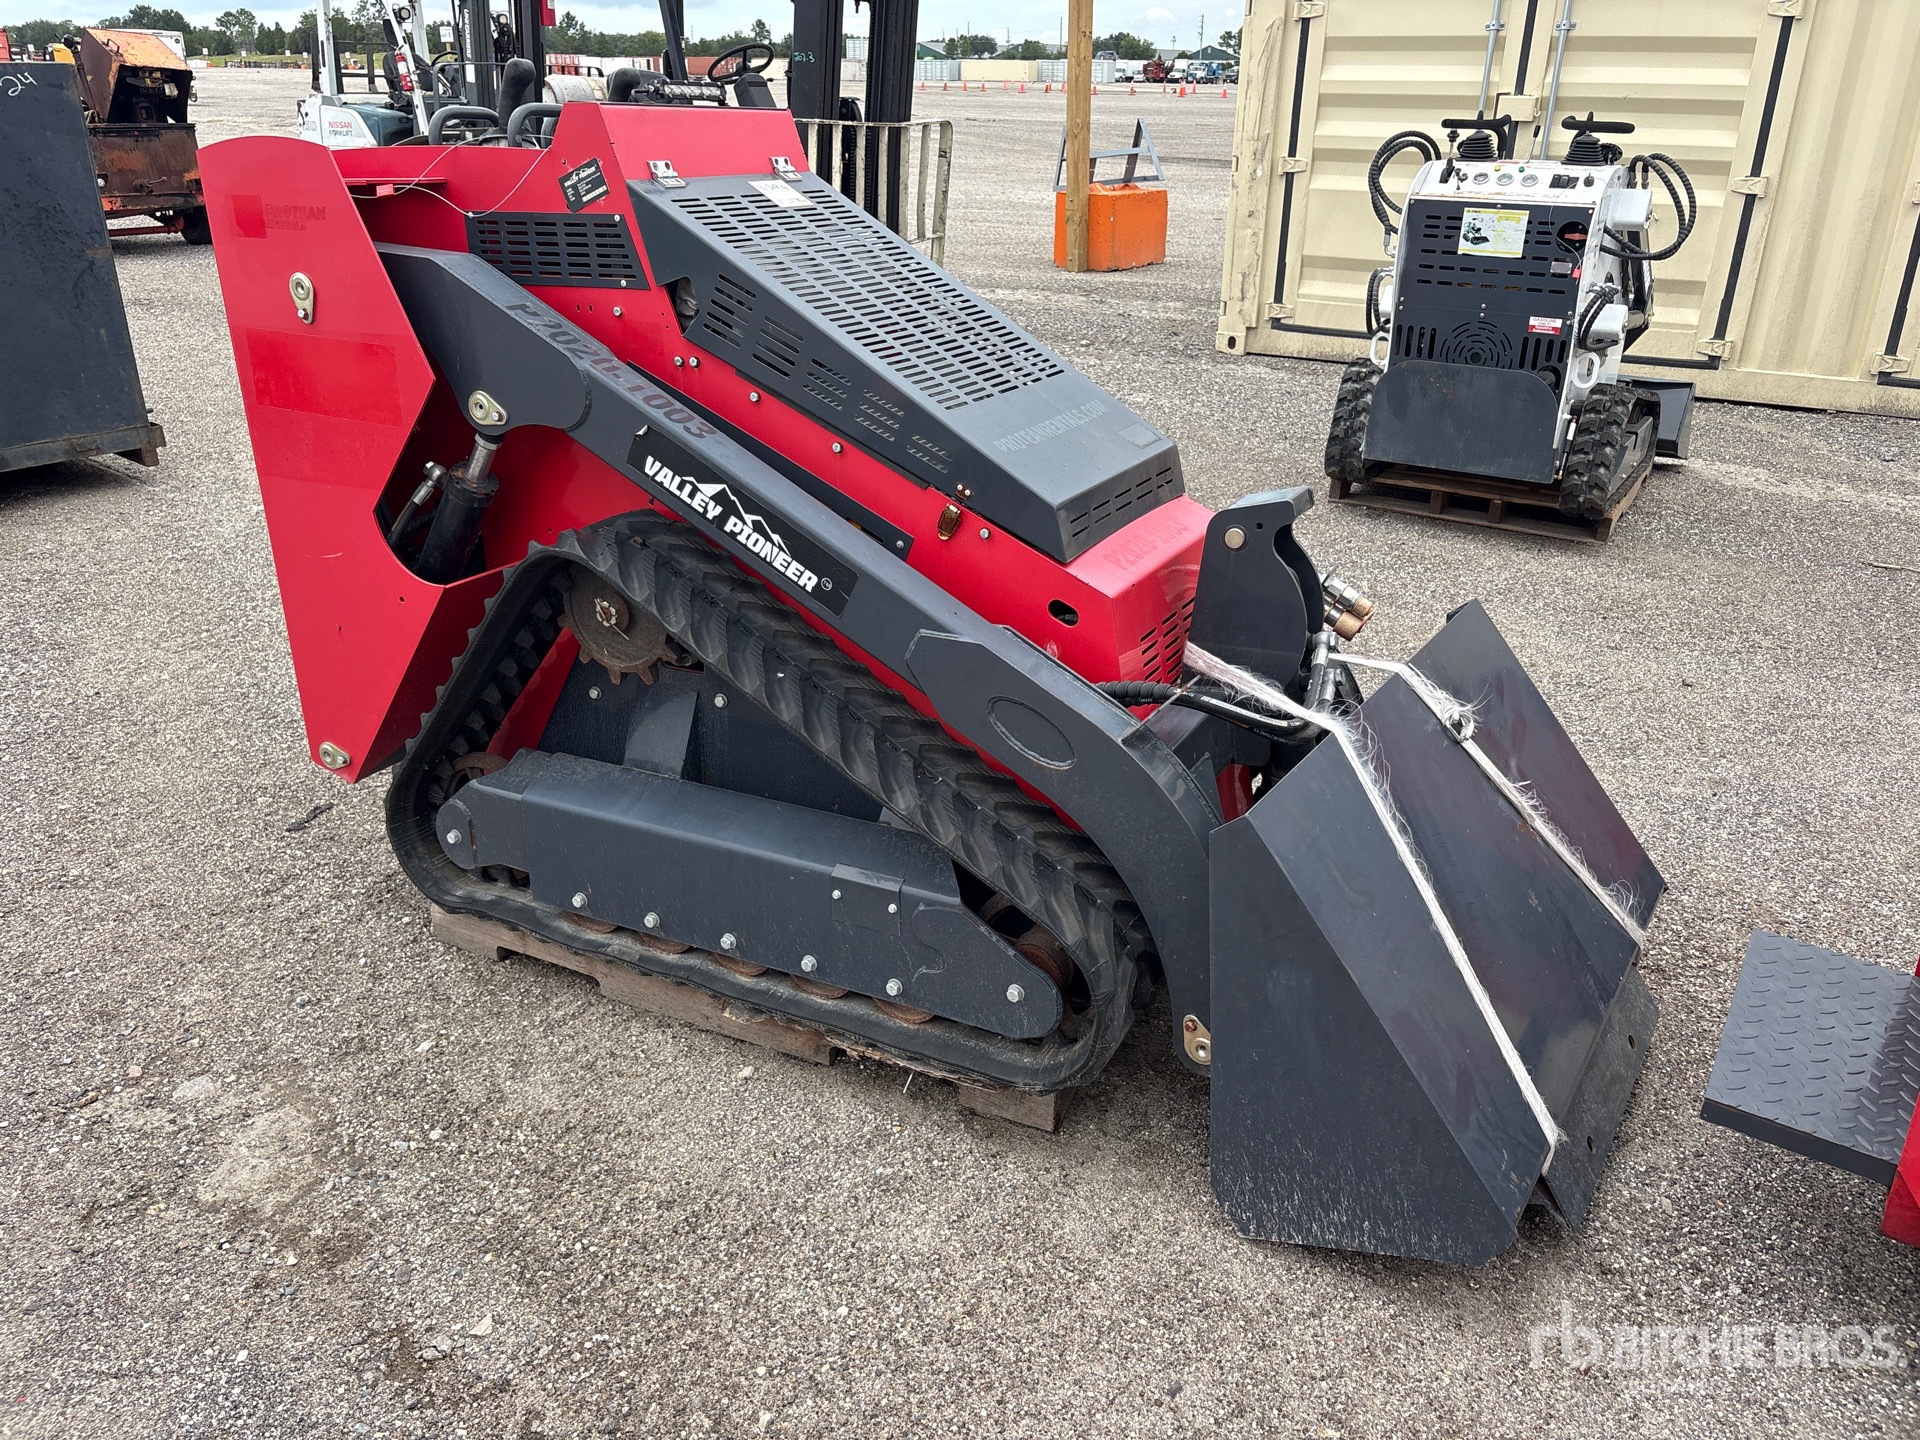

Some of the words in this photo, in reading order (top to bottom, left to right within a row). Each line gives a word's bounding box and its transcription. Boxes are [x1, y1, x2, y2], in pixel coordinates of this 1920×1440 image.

[328, 121, 353, 129] NISSAN
[505, 302, 718, 440] P2020-1003
[644, 455, 723, 521] VALLEY
[723, 515, 819, 593] PIONEER
